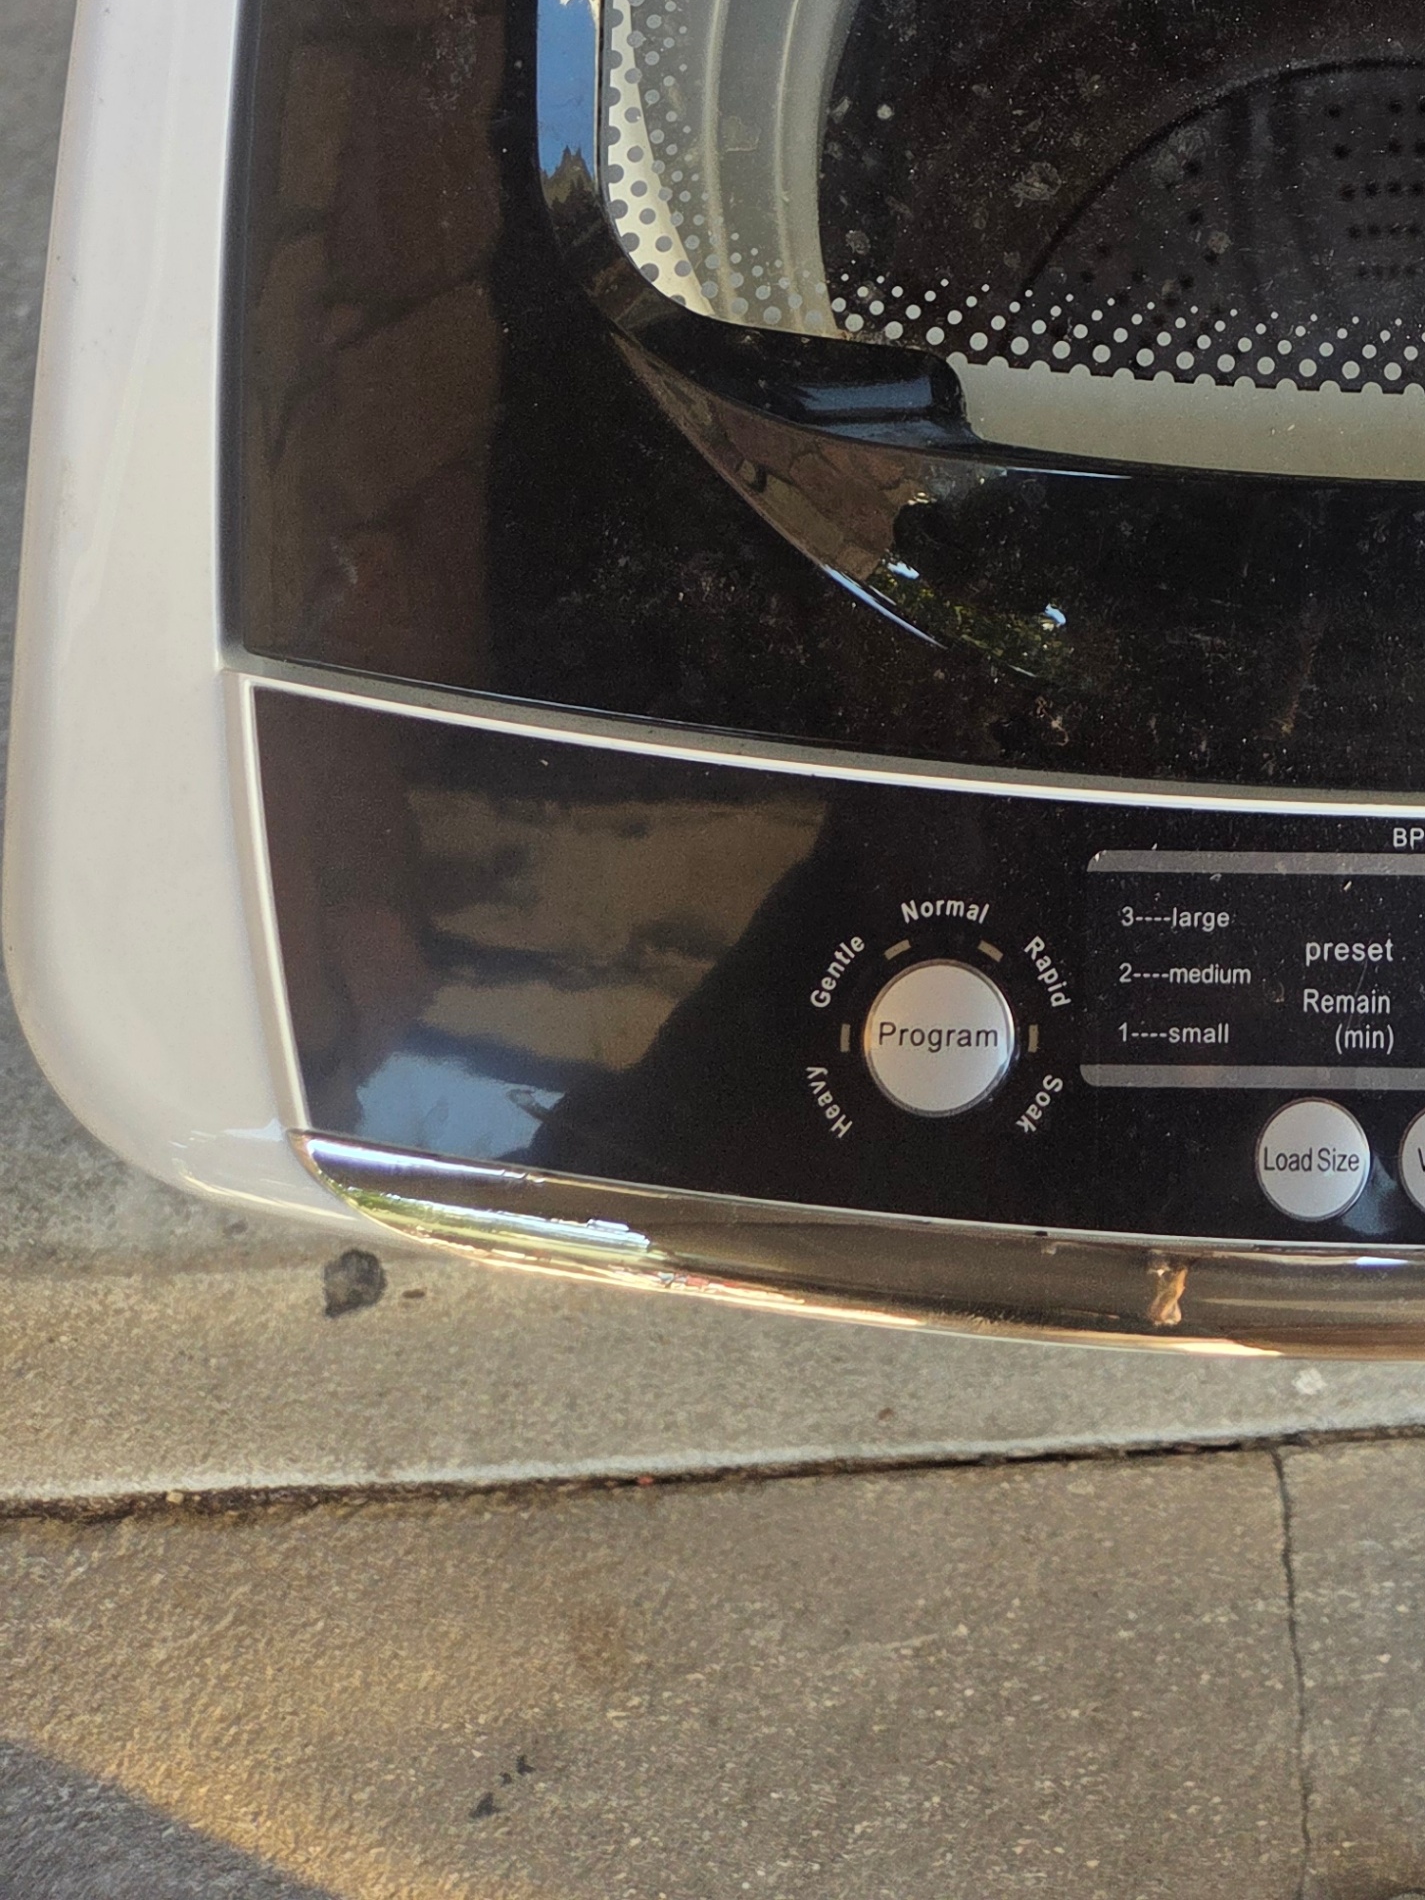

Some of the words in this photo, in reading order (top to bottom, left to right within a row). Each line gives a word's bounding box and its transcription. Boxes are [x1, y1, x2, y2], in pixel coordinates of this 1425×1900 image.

[900, 900, 990, 924] Normal
[1305, 938, 1394, 966] preset
[810, 936, 865, 1008] Gentle
[1023, 936, 1071, 1007] Rapid
[1303, 988, 1391, 1014] Remain
[878, 1021, 999, 1053] Program
[1335, 1023, 1395, 1054] (min)
[806, 1065, 853, 1138] Heavy
[1015, 1074, 1064, 1133] Soak
[1263, 1146, 1312, 1173] Load
[1317, 1147, 1360, 1173] Size
